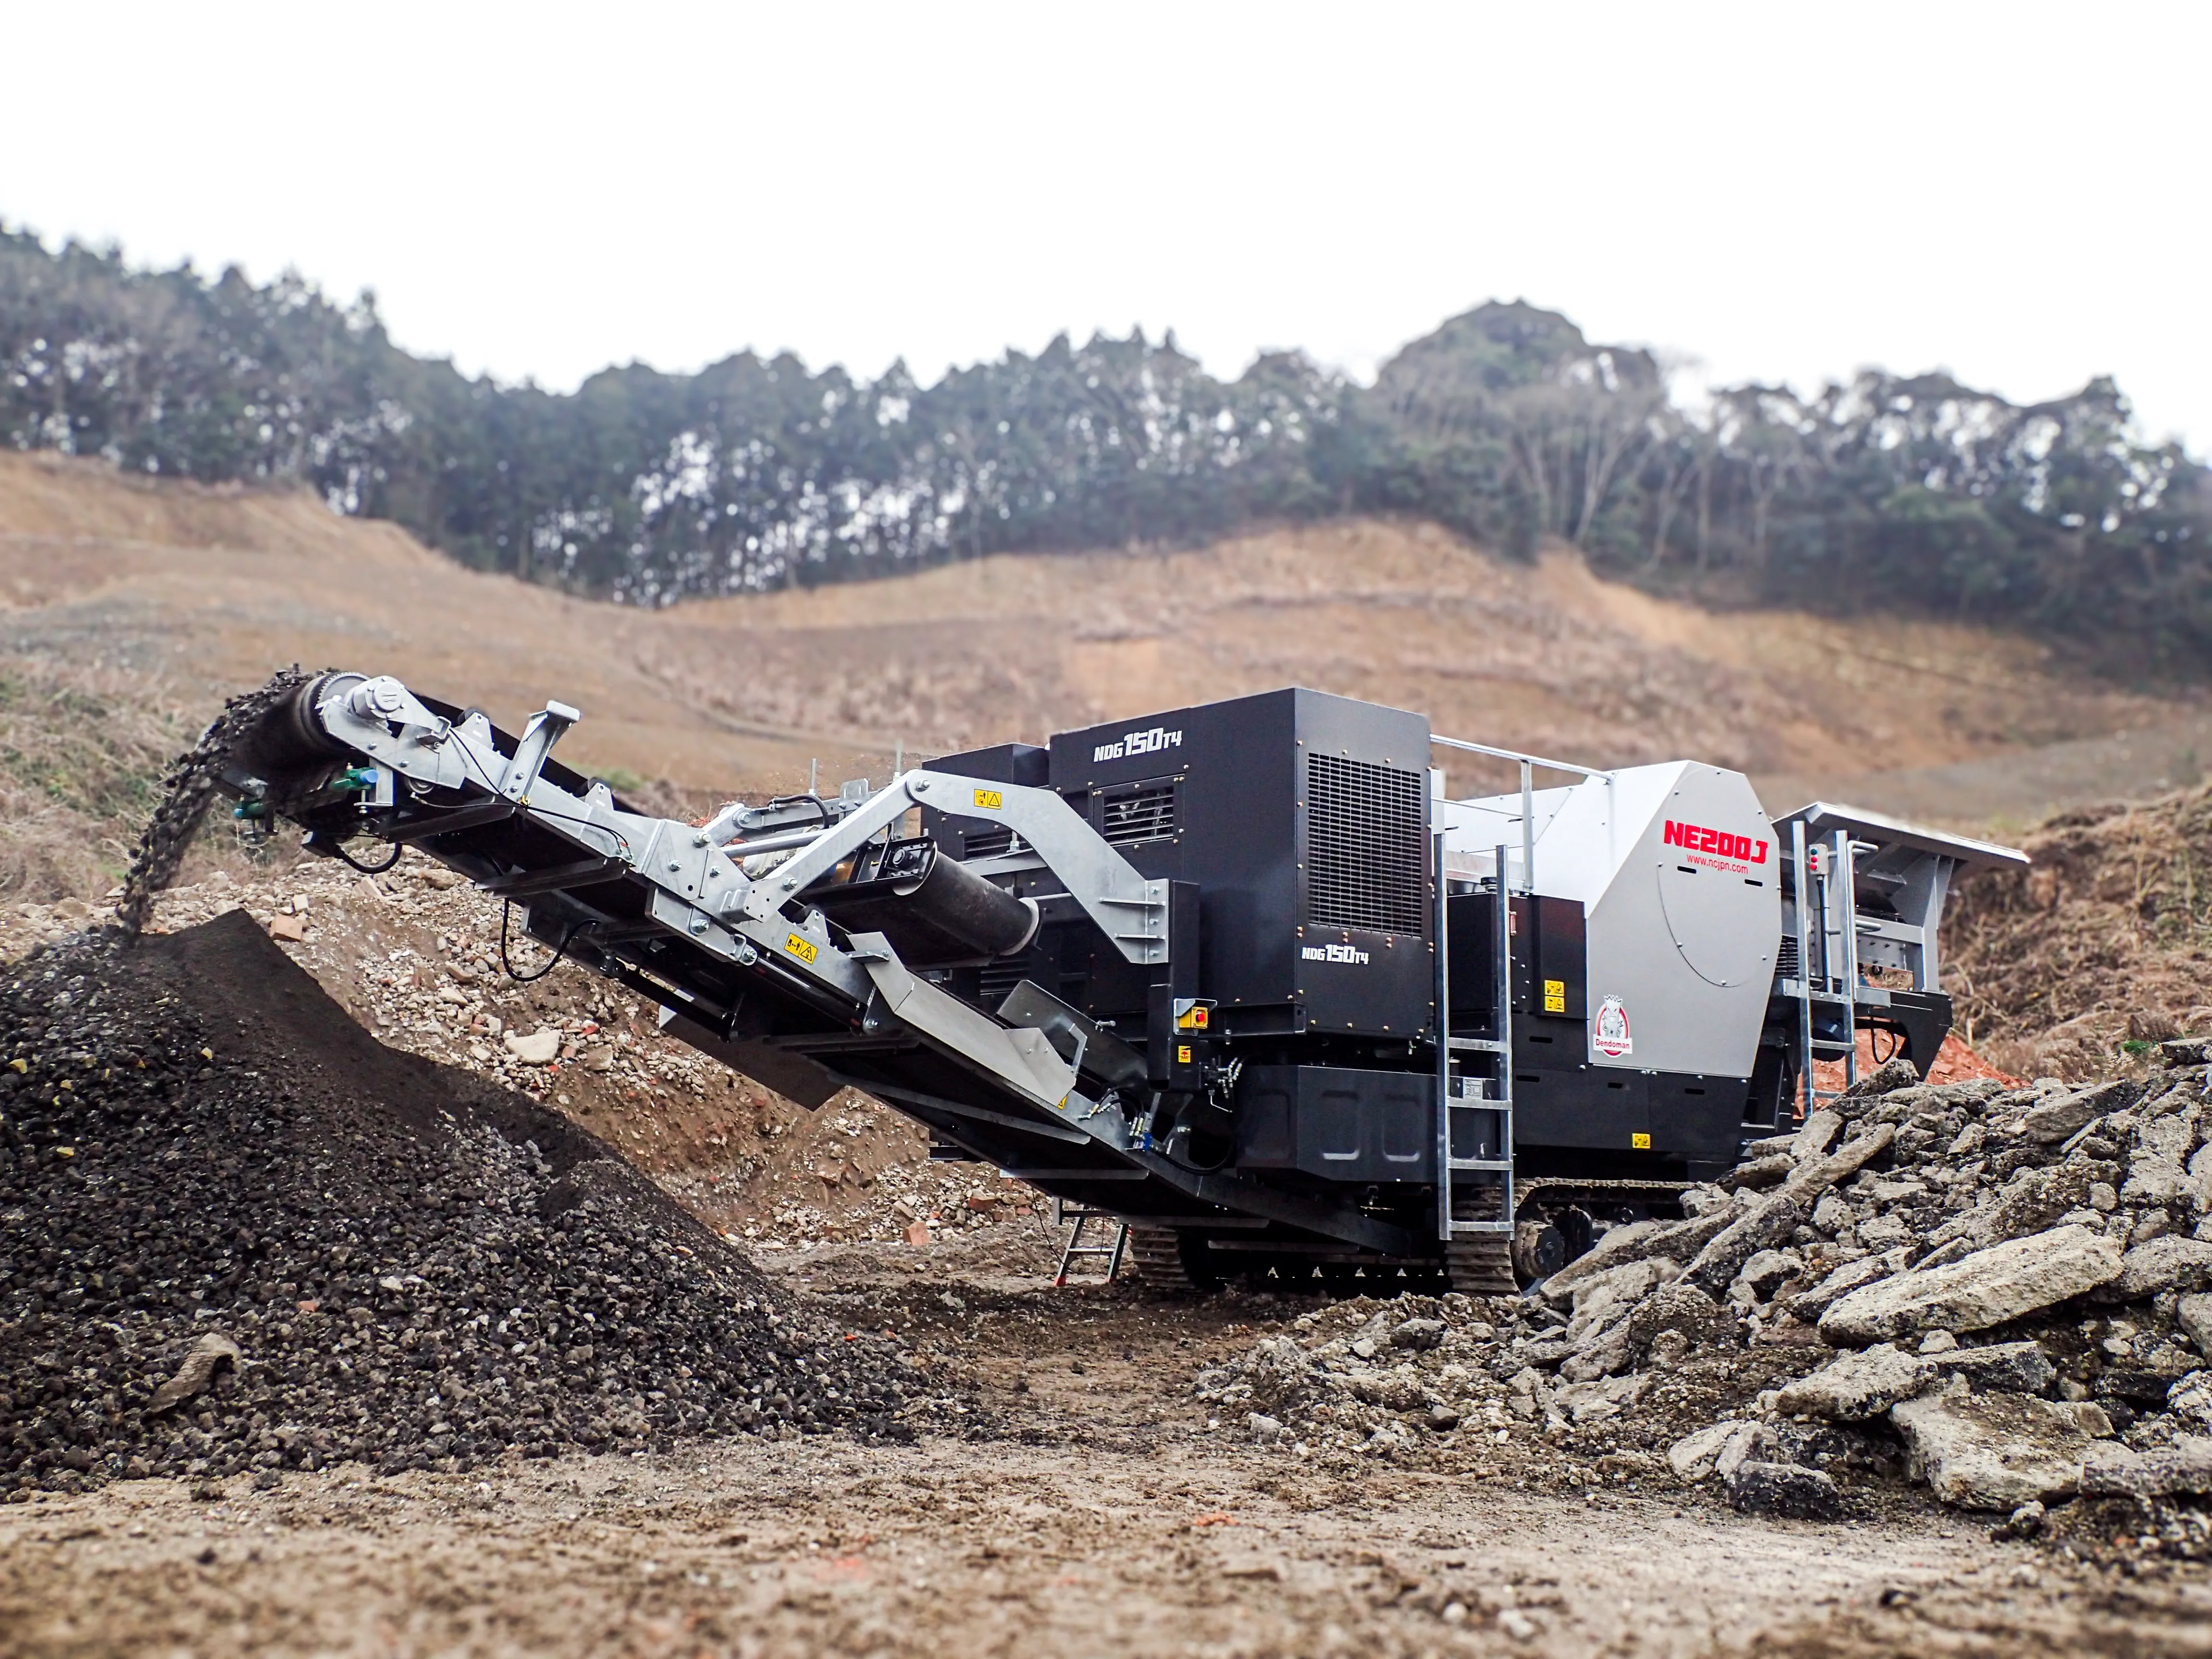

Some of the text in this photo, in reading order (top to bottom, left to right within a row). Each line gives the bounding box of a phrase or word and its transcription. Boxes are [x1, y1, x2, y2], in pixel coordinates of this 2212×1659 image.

[1094, 727, 1182, 762] NDG150T4
[1664, 820, 1768, 864] NE200J
[1686, 854, 1748, 874] www.ncjpn.com
[1301, 944, 1369, 964] NDG150T4
[1596, 1038, 1630, 1049] Dendoman
